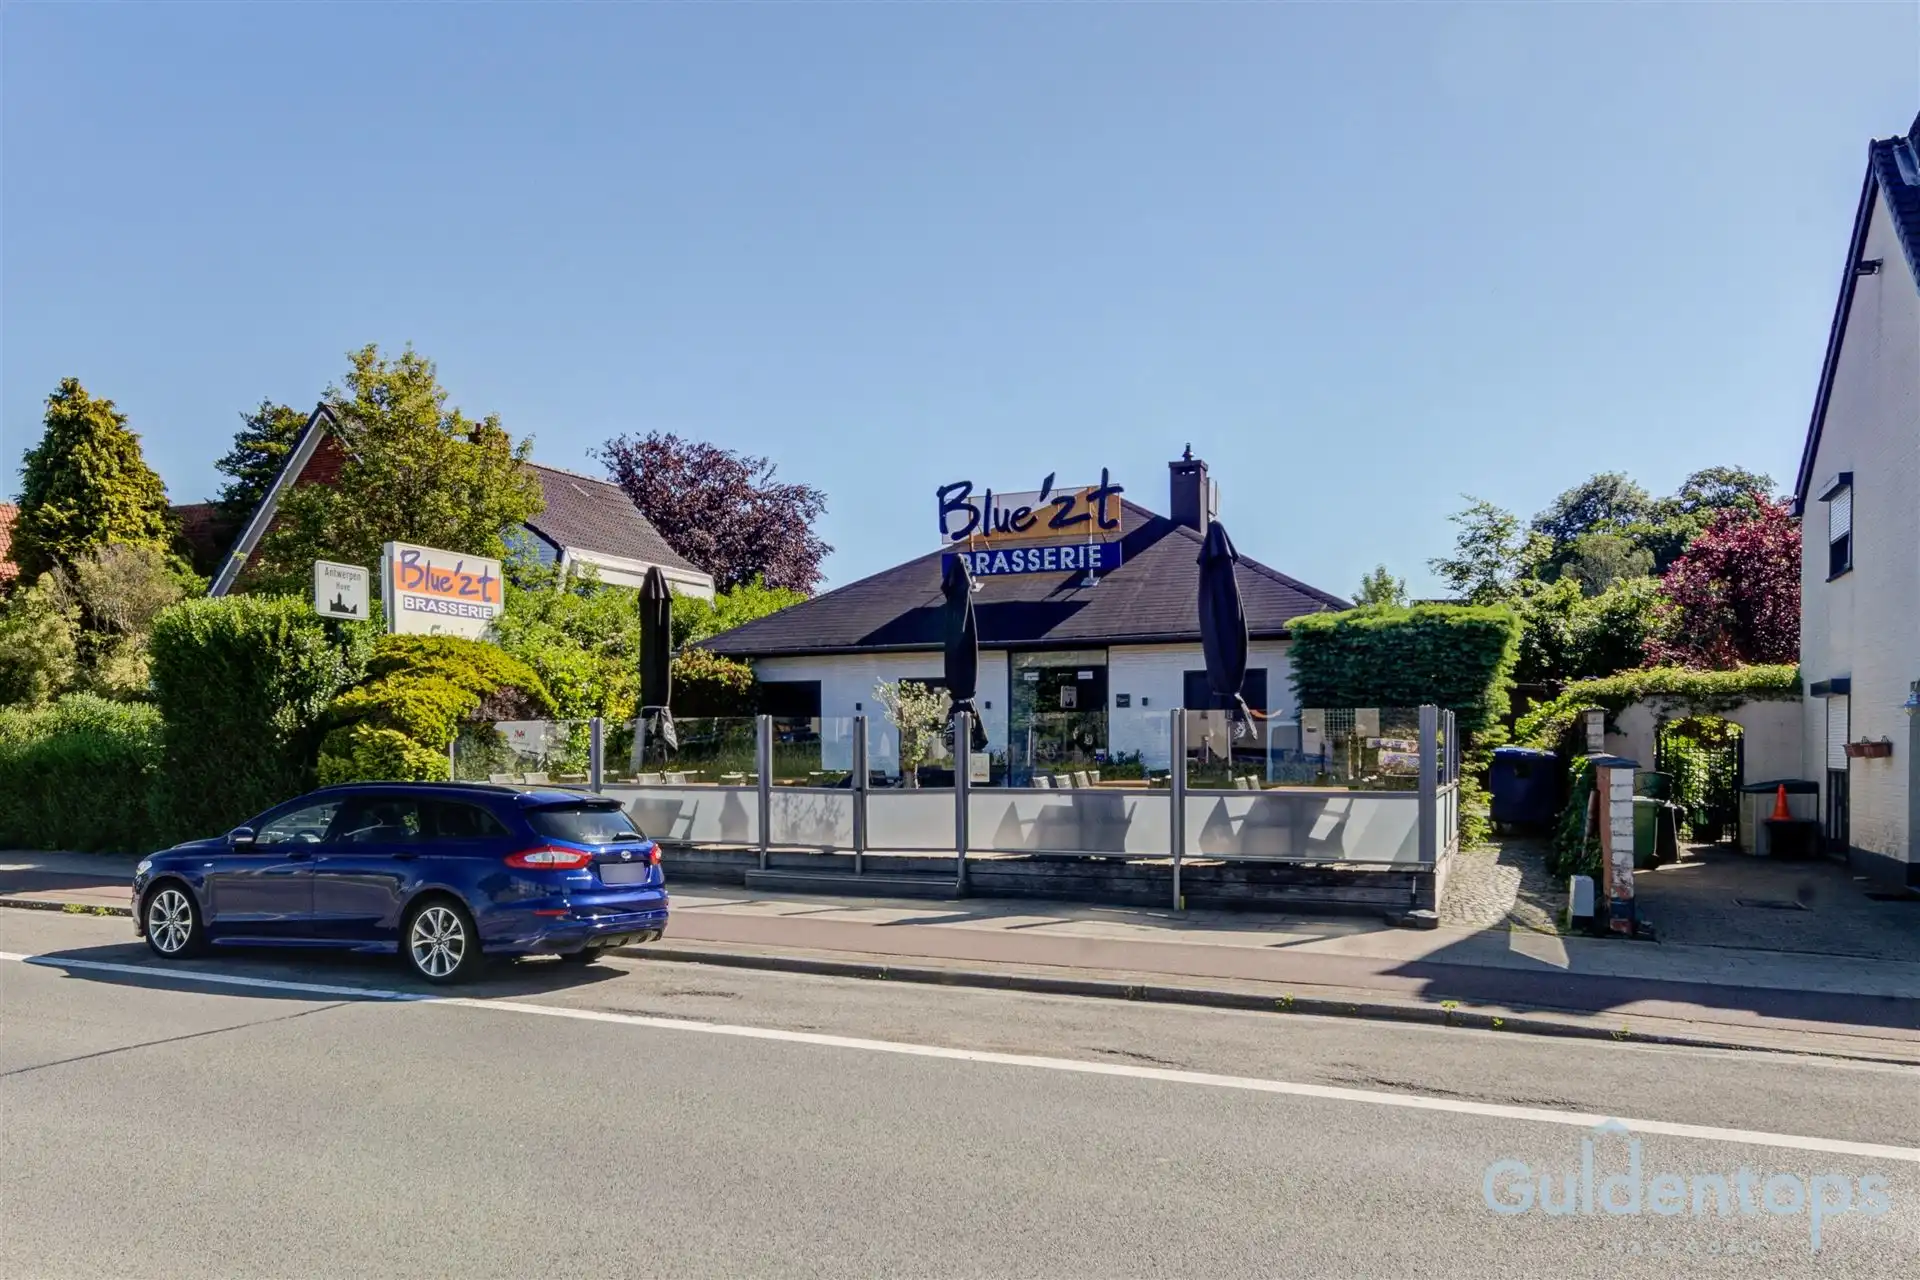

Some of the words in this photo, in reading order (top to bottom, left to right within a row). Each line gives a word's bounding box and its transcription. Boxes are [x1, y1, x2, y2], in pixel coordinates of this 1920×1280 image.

[936, 467, 1124, 540] Blue'zt
[324, 566, 362, 582] Antwerpen
[400, 549, 494, 602] Blue'zt
[403, 596, 493, 619] BRASSERIE
